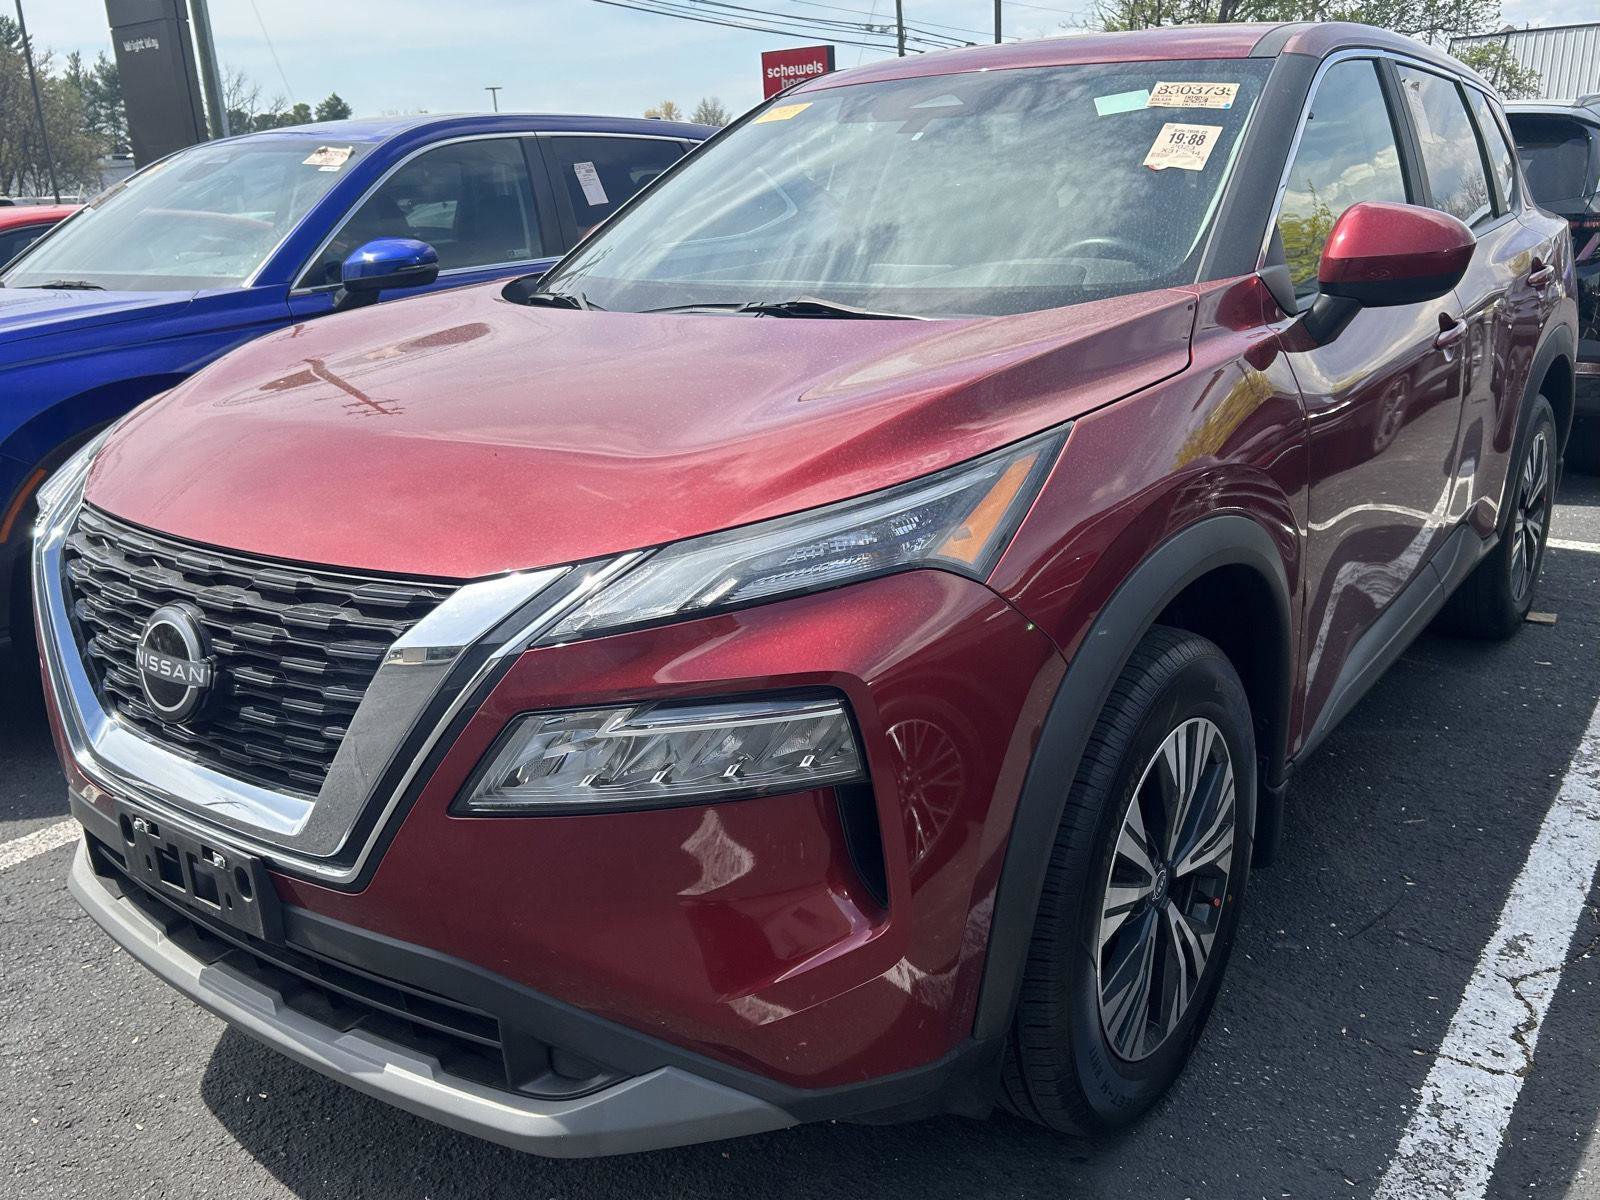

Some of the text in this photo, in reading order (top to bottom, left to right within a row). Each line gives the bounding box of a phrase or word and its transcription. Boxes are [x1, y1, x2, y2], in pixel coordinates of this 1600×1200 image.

[767, 61, 823, 78] schewels
[1169, 133, 1206, 145] 19:88
[136, 647, 205, 684] NISSAN
